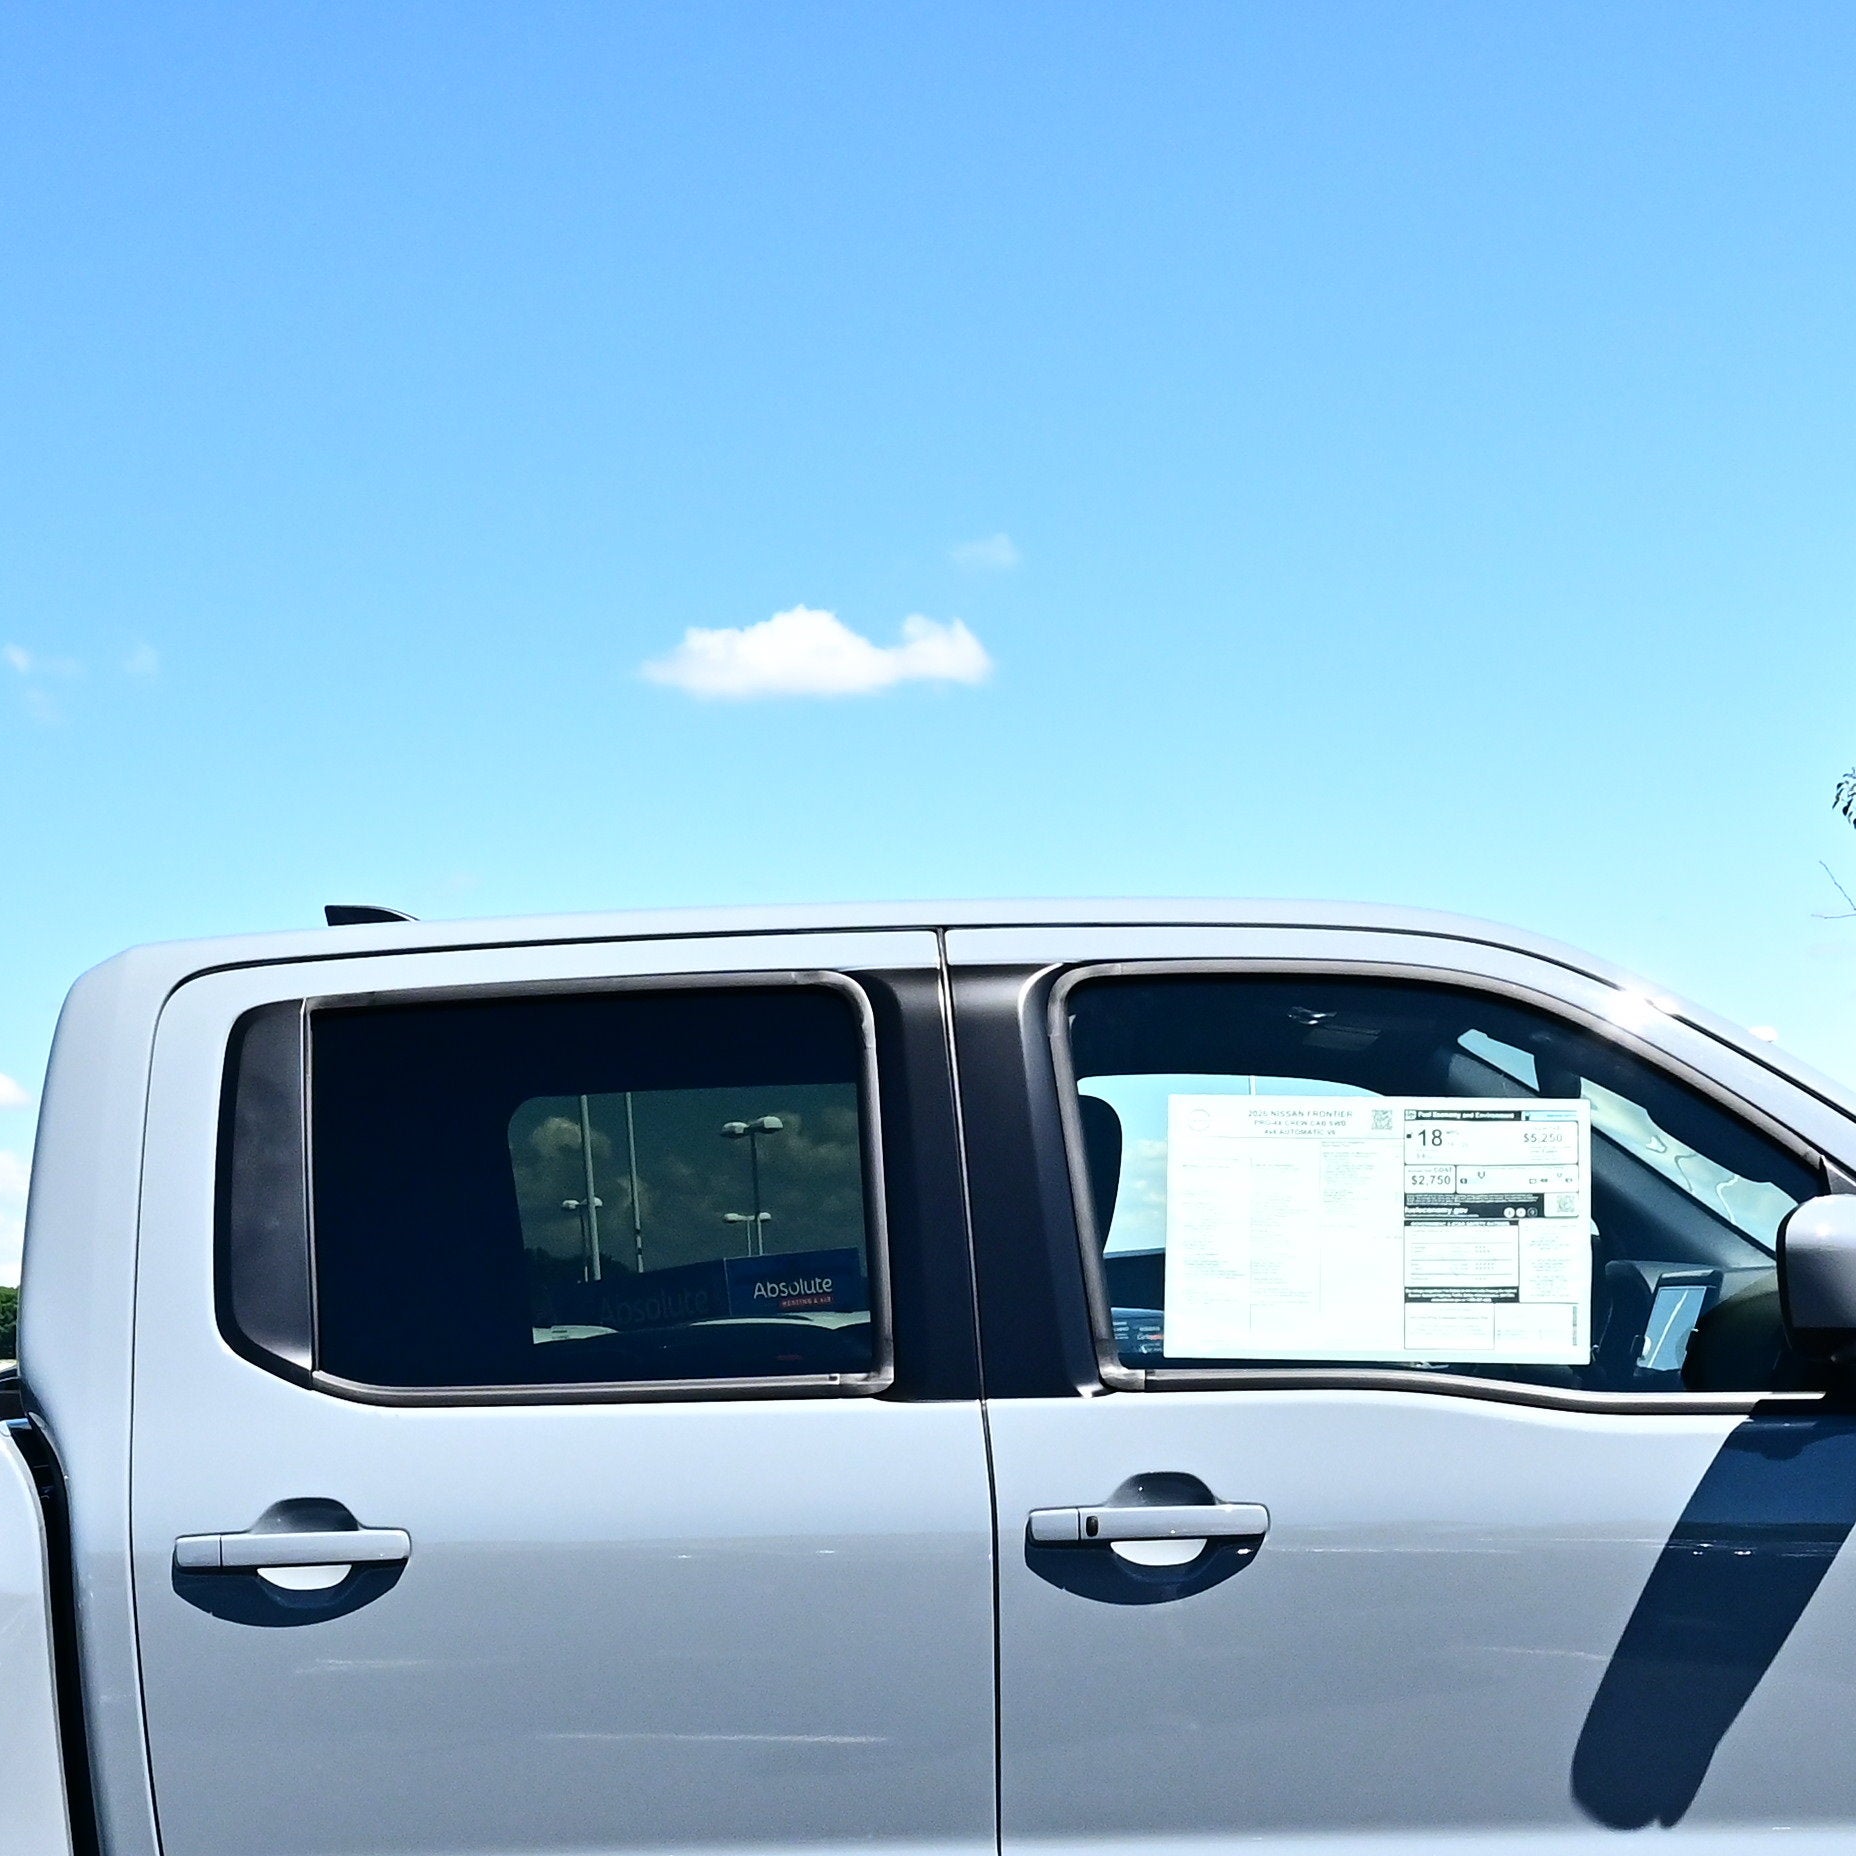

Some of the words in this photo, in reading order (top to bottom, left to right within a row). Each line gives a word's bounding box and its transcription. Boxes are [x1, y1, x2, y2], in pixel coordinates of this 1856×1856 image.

[1418, 1129, 1443, 1147] 18
[1411, 1175, 1451, 1187] $2,750
[753, 1277, 833, 1299] Absolute
